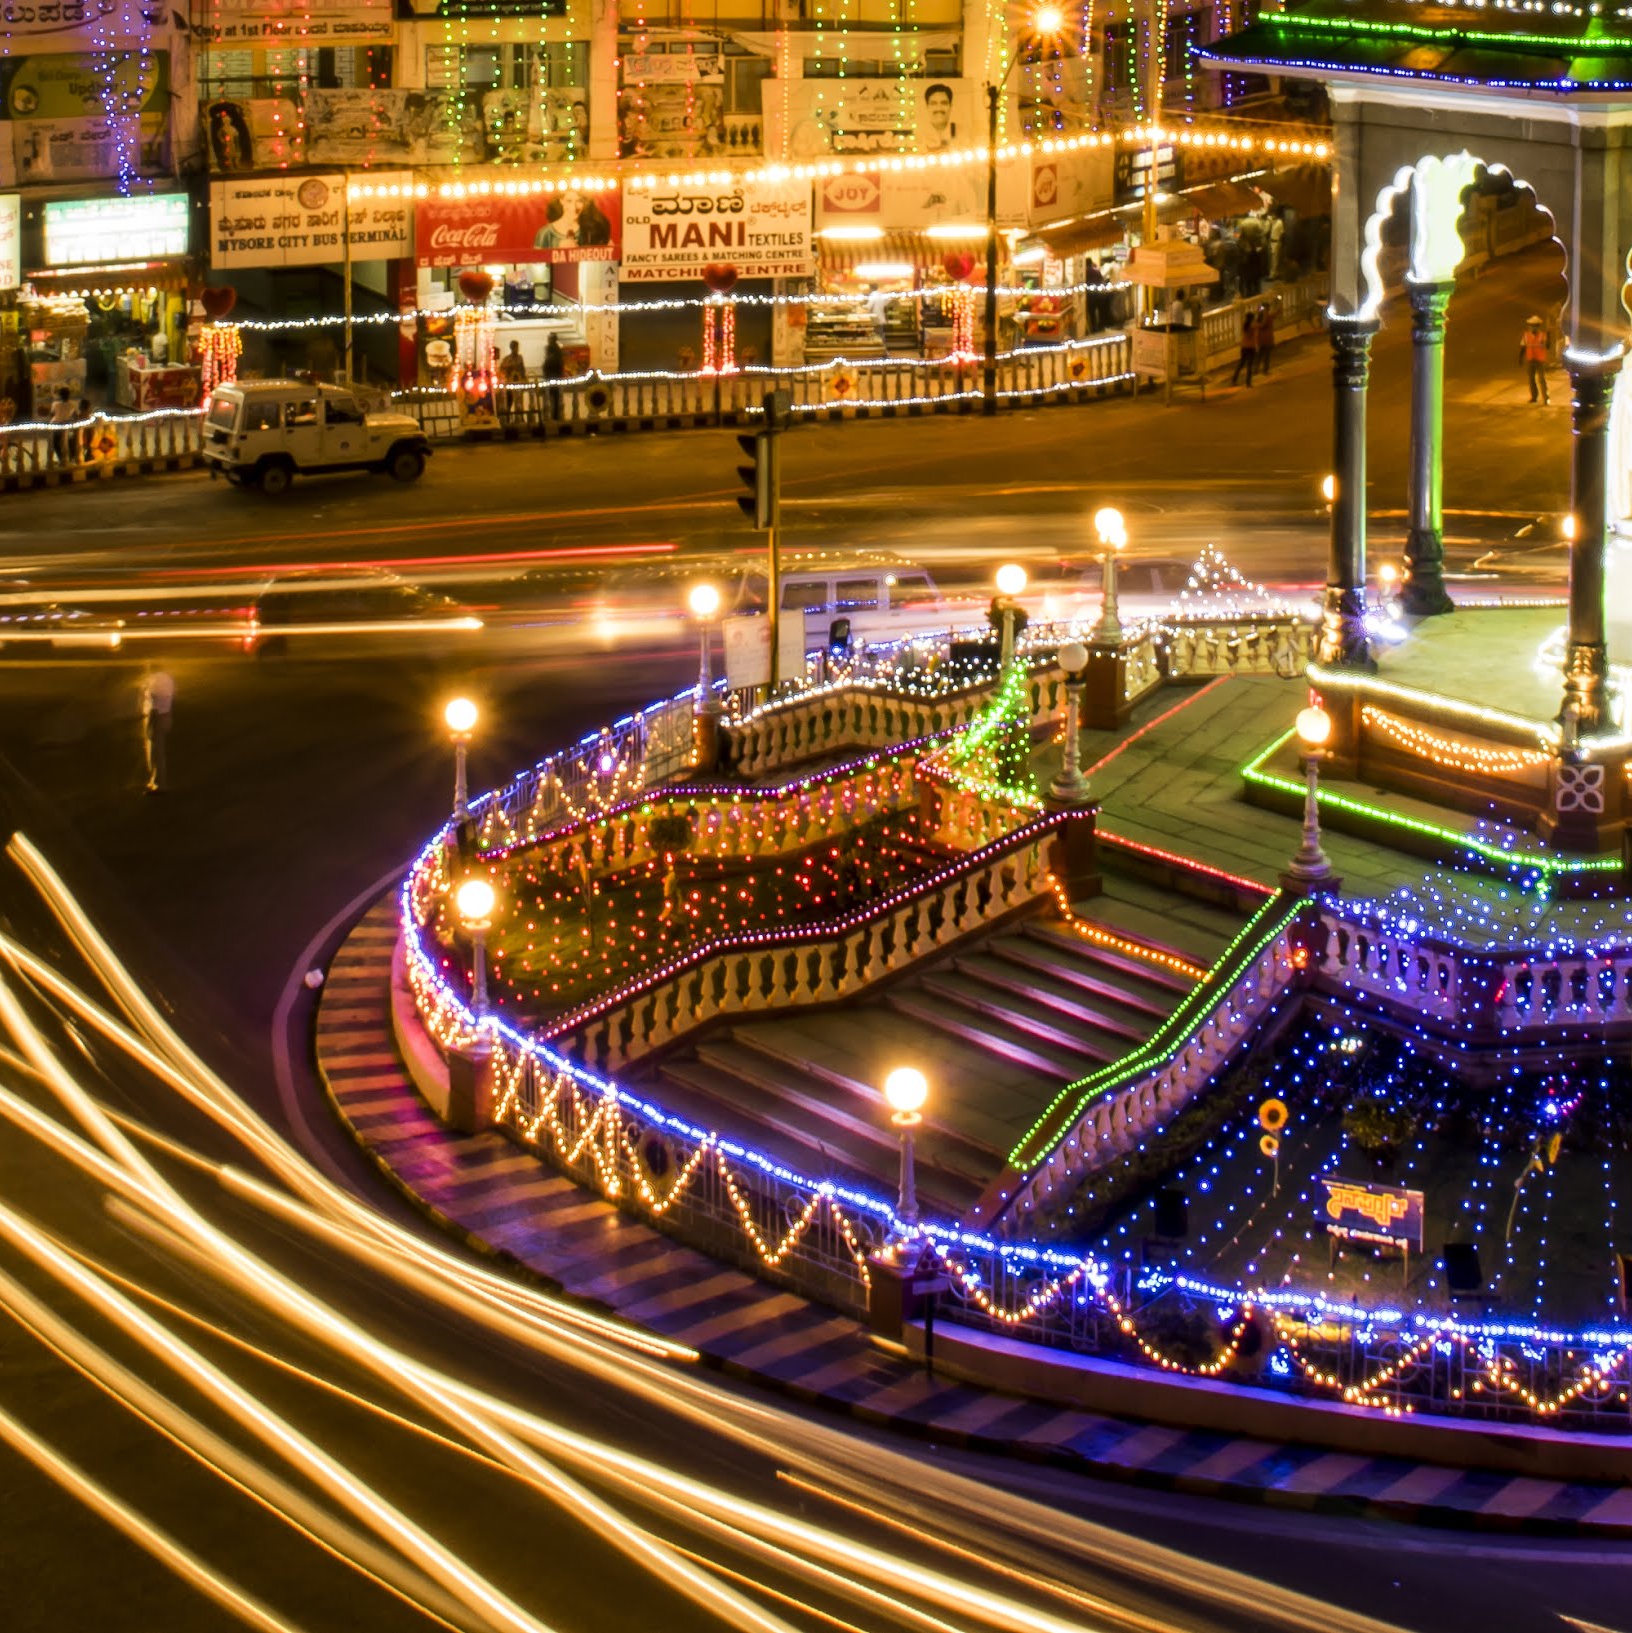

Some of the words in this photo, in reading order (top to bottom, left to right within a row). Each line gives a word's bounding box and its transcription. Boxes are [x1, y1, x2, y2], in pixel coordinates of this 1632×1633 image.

[225, 24, 237, 36] at
[240, 24, 259, 36] 1st
[263, 23, 292, 36] Floor
[651, 187, 745, 216] ಮಾಣಿ
[834, 187, 869, 201] JOY
[272, 214, 302, 230] ನಗರ
[218, 236, 275, 253] MYSORE
[278, 235, 309, 249] CITY
[312, 233, 338, 246] BUS
[341, 228, 407, 245] TERMINAL
[626, 216, 651, 225] OLD
[649, 221, 746, 249] MANI
[747, 232, 804, 247] TEXTILES
[551, 249, 567, 263] DA
[569, 247, 614, 263] HIDEOUT
[626, 253, 658, 263] FANCY
[661, 251, 699, 262] SAREES
[702, 251, 708, 261] &
[712, 250, 763, 261] MATCHING
[765, 249, 804, 259] CENTRE
[627, 266, 705, 279] MATCHI
[737, 264, 807, 276] CENTRE
